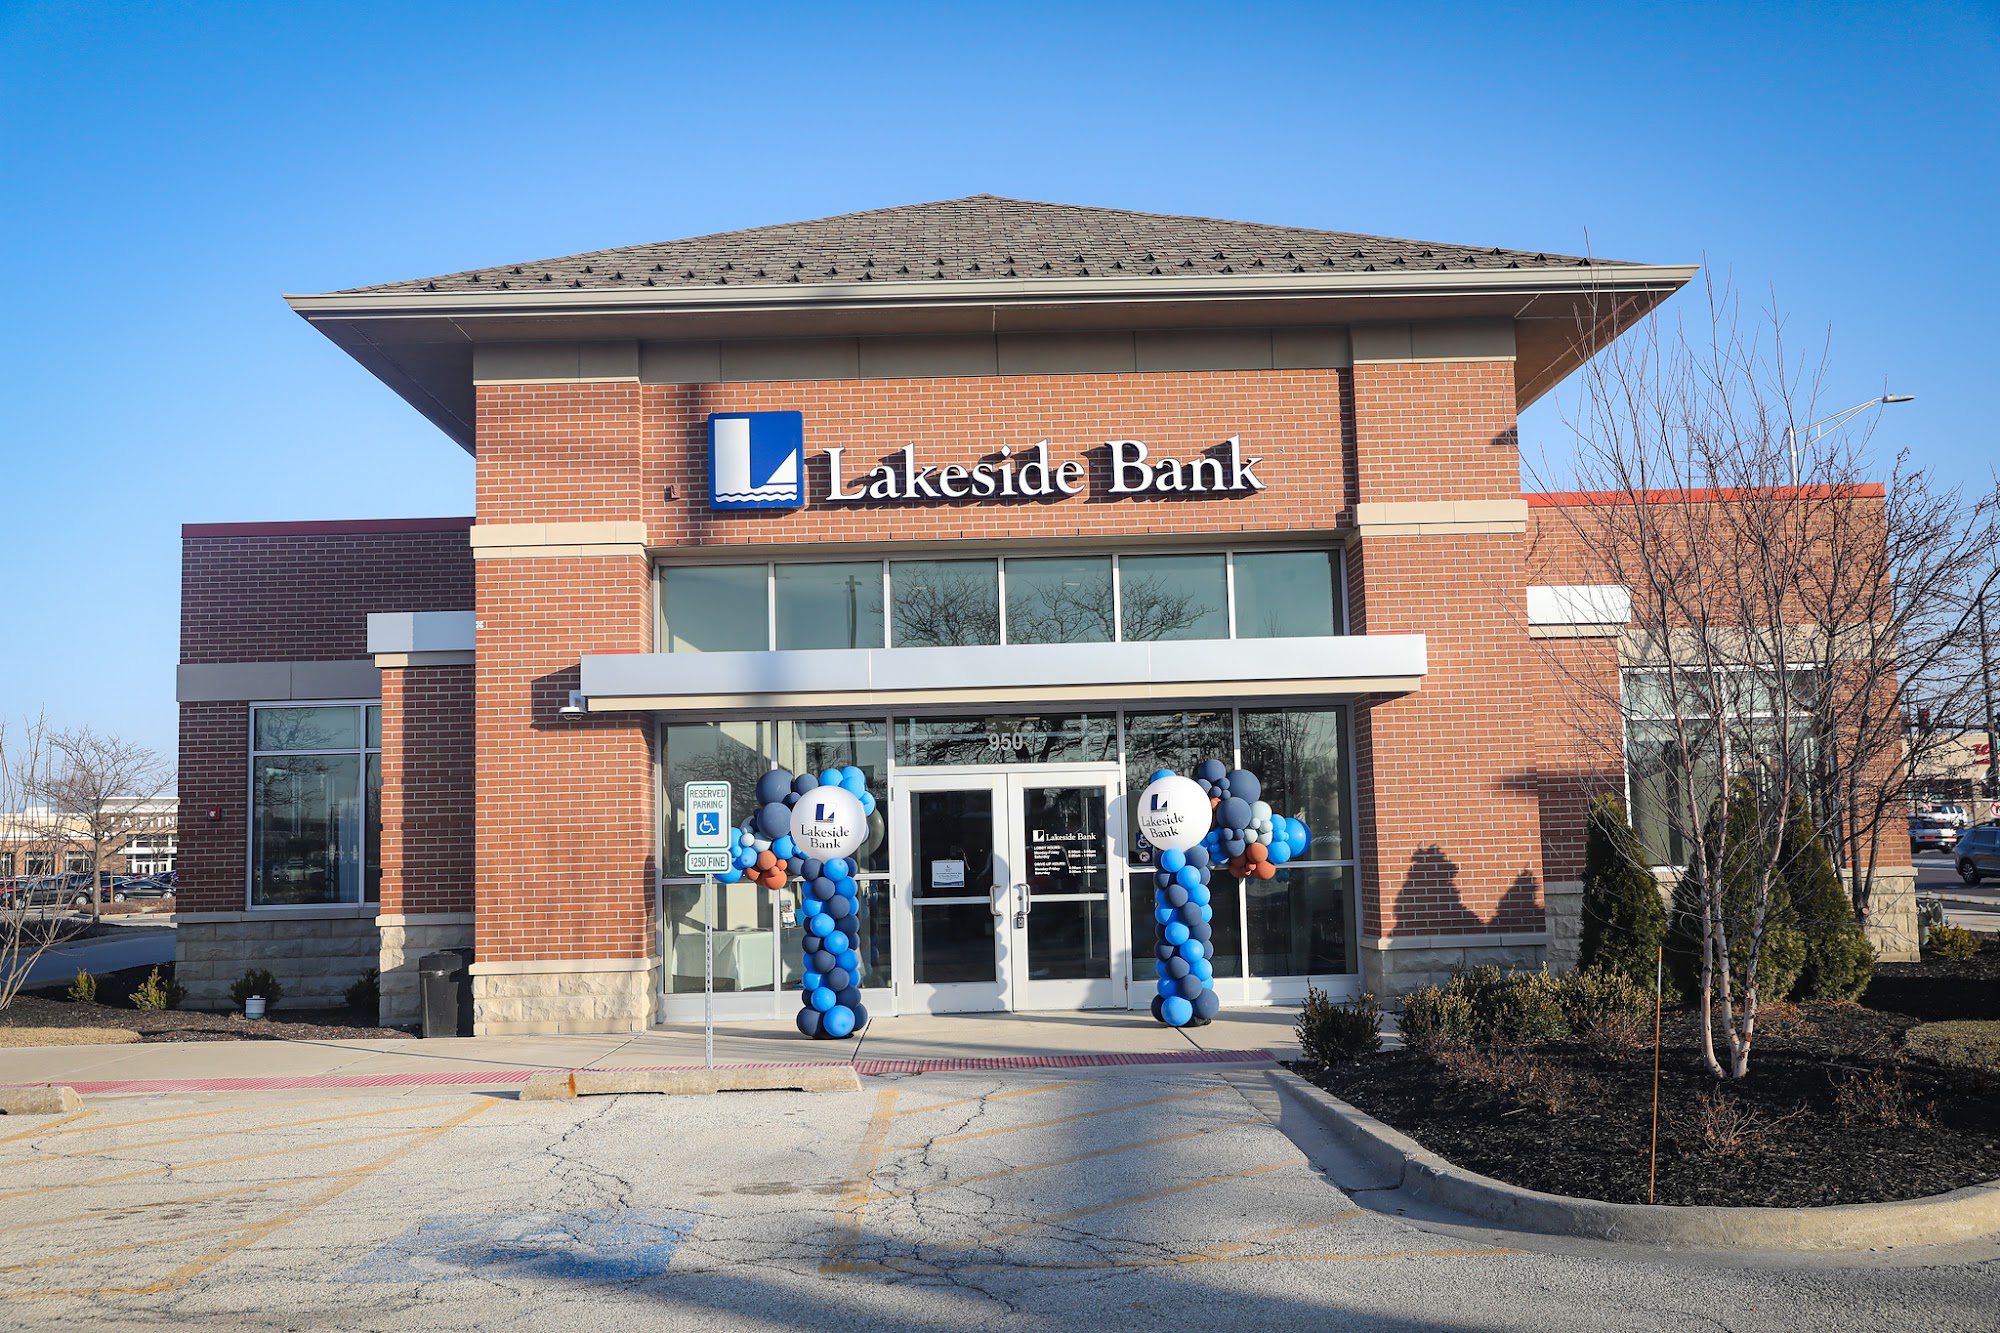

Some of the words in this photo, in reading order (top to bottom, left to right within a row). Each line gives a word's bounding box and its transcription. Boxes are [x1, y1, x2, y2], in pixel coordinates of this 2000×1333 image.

[822, 438, 1087, 501] Lakeside
[1104, 433, 1268, 493] Bank
[988, 732, 1024, 751] 950
[689, 789, 726, 798] RESERVED
[692, 800, 723, 809] PARKING
[110, 816, 133, 828] LA
[1141, 812, 1184, 827] Lakeside
[800, 824, 850, 838] Lakeside
[1045, 832, 1076, 841] Lakeside
[1077, 832, 1097, 841] Bank
[1149, 826, 1179, 838] Bank
[810, 837, 841, 848] Bank
[690, 857, 706, 867] $250
[708, 856, 726, 867] FINE
